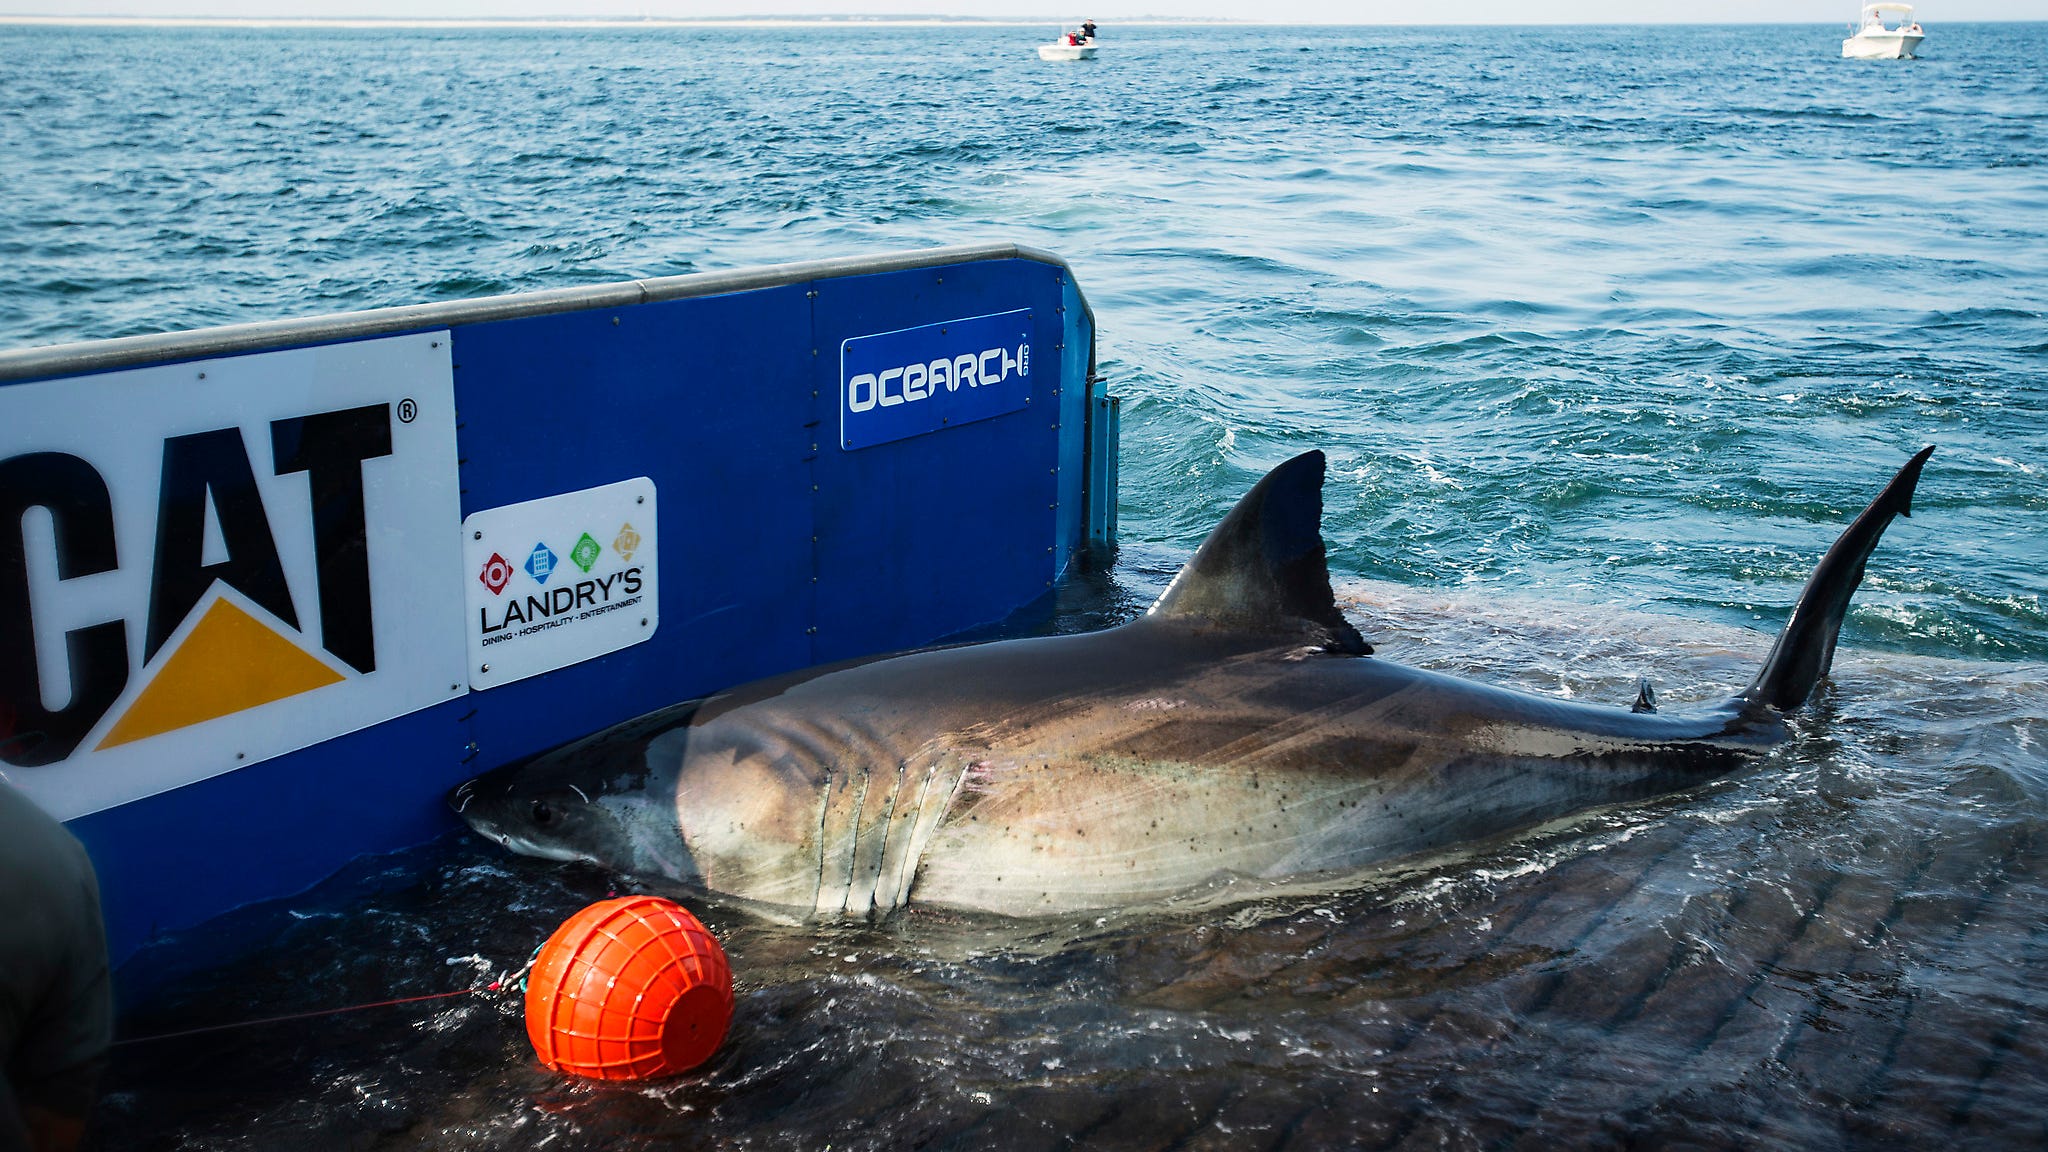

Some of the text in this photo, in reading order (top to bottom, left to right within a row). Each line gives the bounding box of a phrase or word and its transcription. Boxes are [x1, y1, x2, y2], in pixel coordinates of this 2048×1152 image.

[482, 596, 642, 646] DINING HOSPITALITY ENTERTAINMENT
